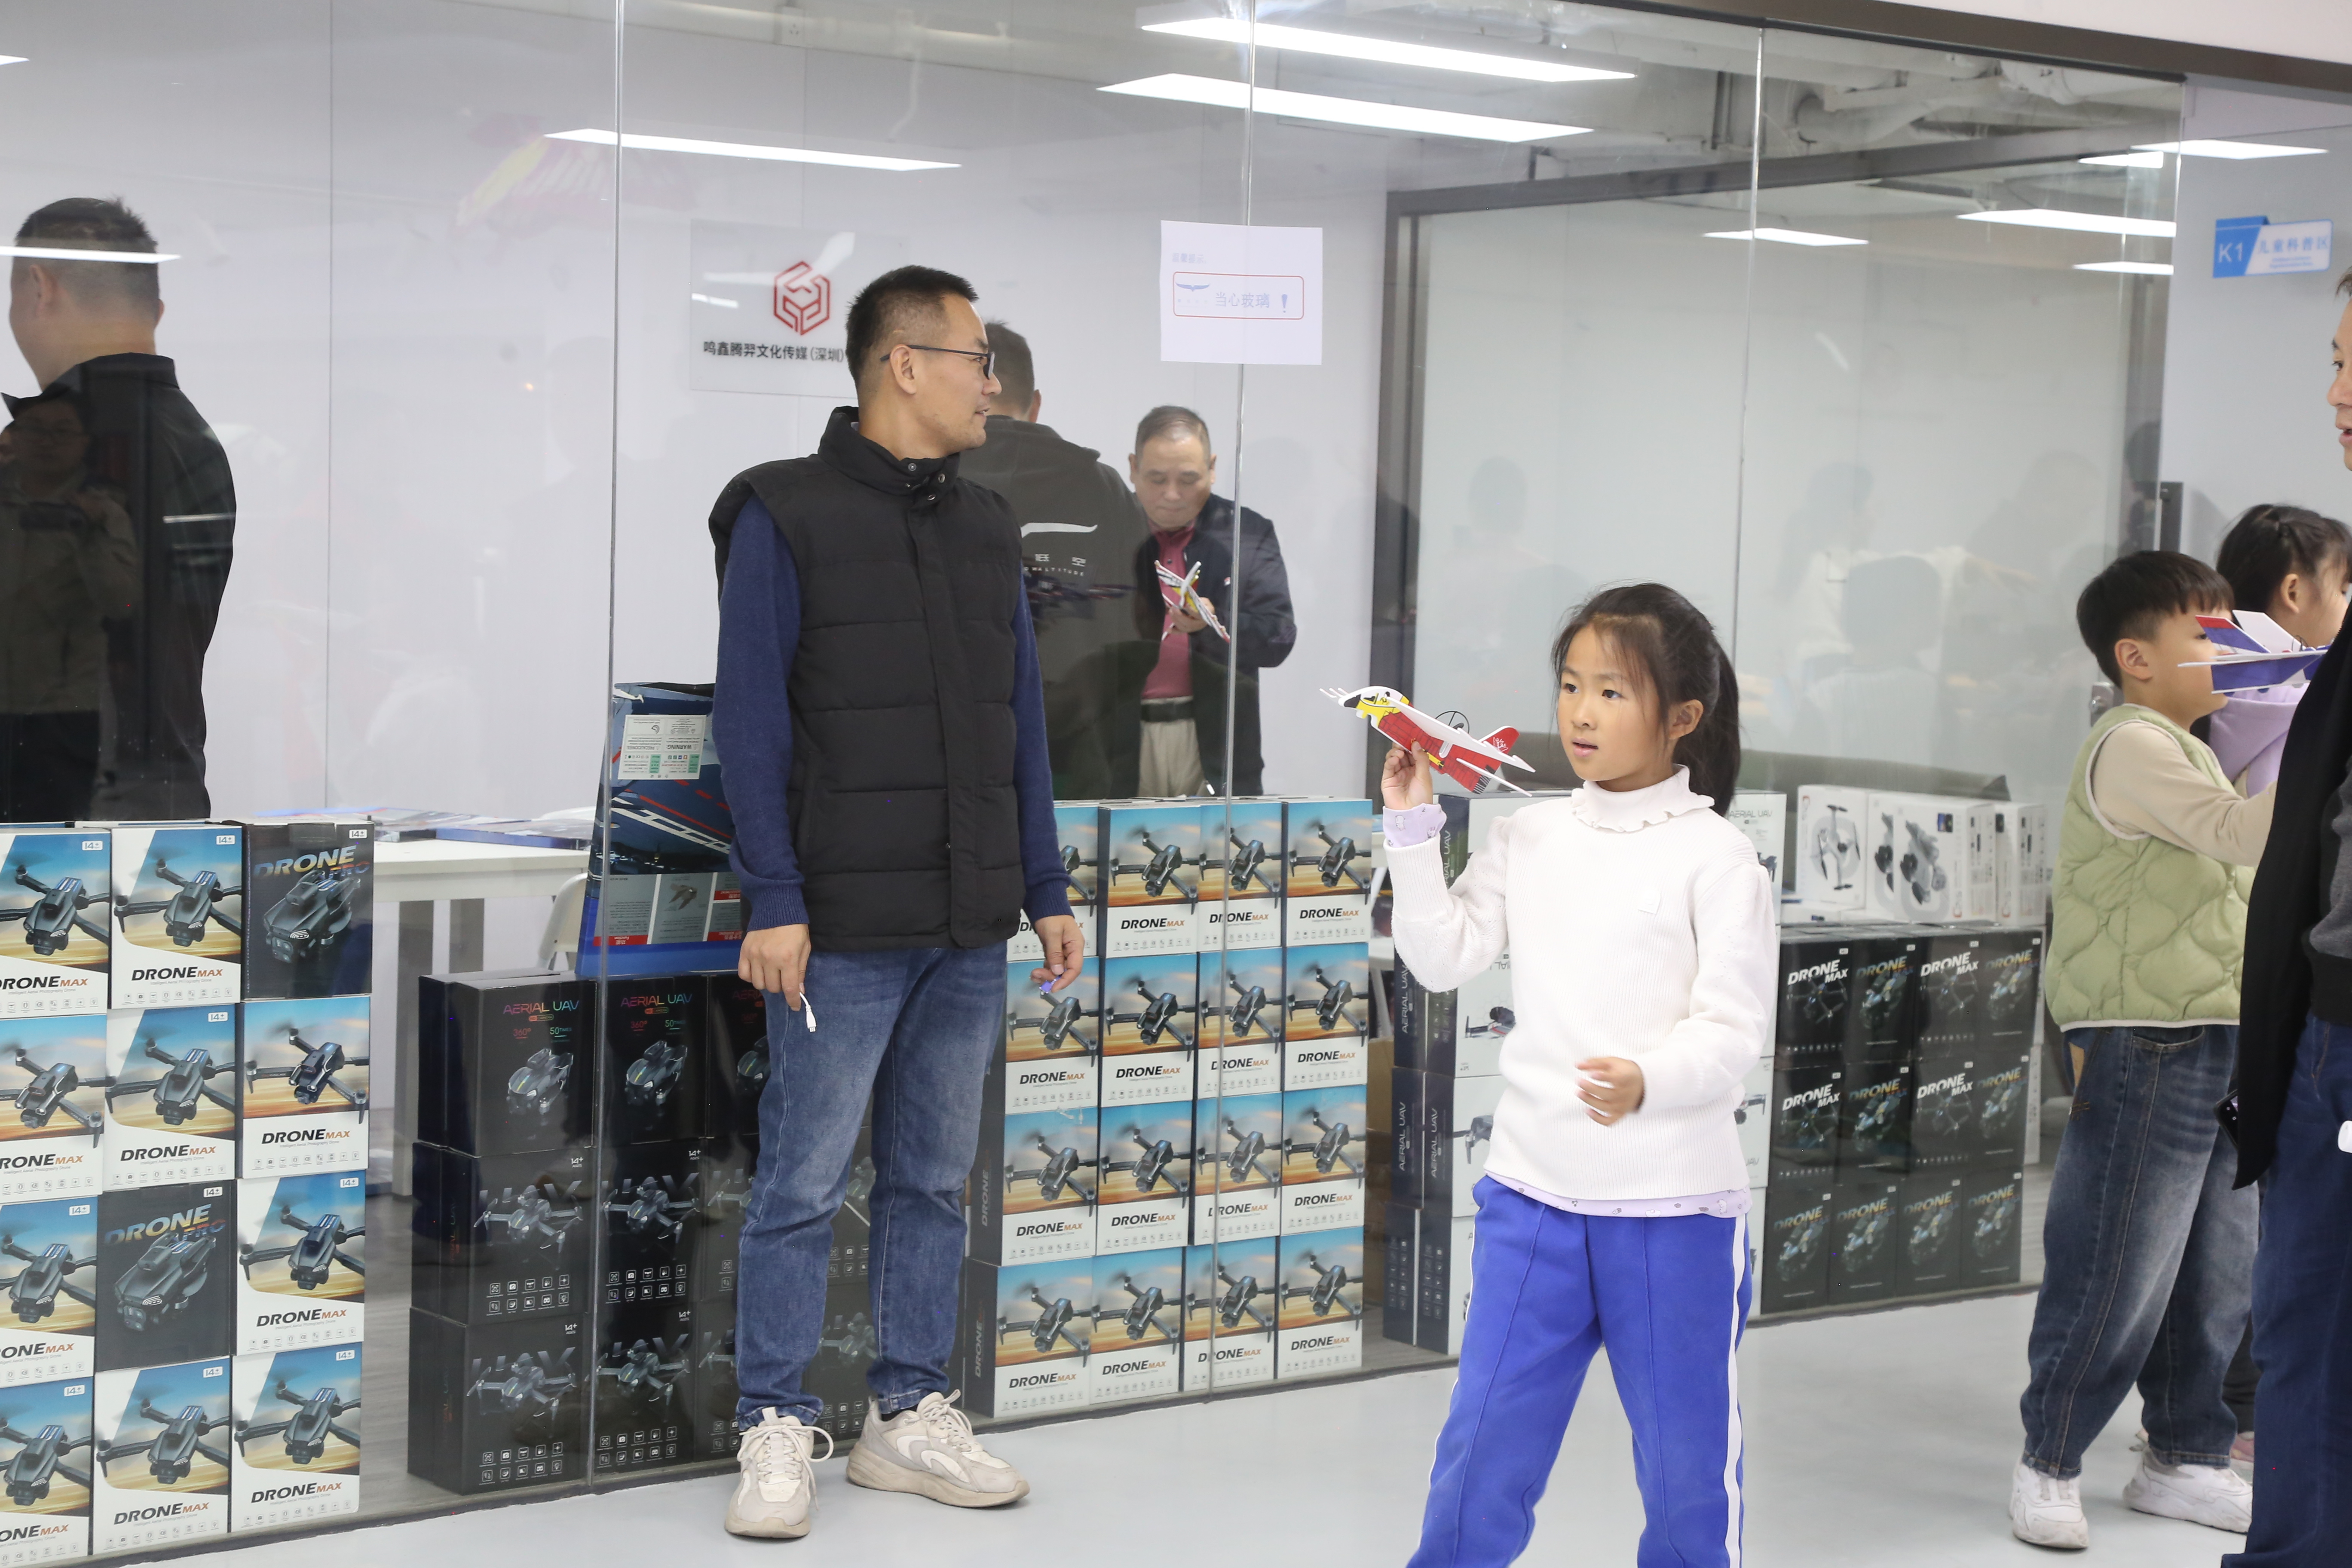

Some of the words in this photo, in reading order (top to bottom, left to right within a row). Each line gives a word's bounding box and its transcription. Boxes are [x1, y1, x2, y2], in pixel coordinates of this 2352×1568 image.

[2218, 242, 2243, 263] K1
[253, 845, 356, 877] DRONE
[328, 861, 370, 879] PRO
[1300, 908, 1342, 919] DRONE
[1121, 918, 1167, 929] DRONE
[1856, 956, 1907, 977] DRONE
[1921, 952, 1971, 977] DRONE
[1985, 949, 2033, 970] DRONE
[132, 967, 198, 981] DRONE
[197, 969, 224, 977] MAX
[1788, 959, 1840, 985] DRONE
[1825, 968, 1848, 983] MAX
[1957, 961, 1979, 975] MAX
[0, 976, 61, 989] RONE
[60, 979, 89, 987] MAX
[503, 1002, 549, 1014] AERIAL
[553, 1000, 580, 1011] UAV
[621, 996, 665, 1008] AERIAL
[668, 993, 693, 1004] UAV
[1298, 1051, 1339, 1063] DRONE
[1020, 1072, 1067, 1084] DRONE
[1116, 1066, 1163, 1078] DRONE
[1849, 1078, 1901, 1099] DRONE
[1917, 1072, 1966, 1099] DRONE
[1951, 1081, 1973, 1096] MAX
[1782, 1083, 1833, 1111] DRONE
[1818, 1092, 1841, 1108] MAX
[261, 1129, 326, 1144] DRONE
[325, 1131, 350, 1139] MAX
[120, 1145, 190, 1161] DRONE
[189, 1146, 216, 1155] MAX
[0, 1154, 56, 1169] RONE
[55, 1155, 84, 1164] MAX
[1295, 1194, 1337, 1207] DRONE
[1904, 1191, 1953, 1213] DRONE
[1837, 1197, 1888, 1220] DRONE
[1111, 1213, 1158, 1226] DRONE
[1774, 1205, 1823, 1228] DRONE
[104, 1204, 211, 1245] DRONE
[183, 1219, 226, 1241] PRO
[1017, 1222, 1064, 1236] DRONE
[257, 1309, 322, 1327] DRONE
[322, 1309, 347, 1319] MAX
[0, 1343, 46, 1358] ONE
[45, 1343, 75, 1354] MAX
[1291, 1336, 1334, 1351] DRONE
[1198, 1348, 1244, 1363] DONE
[1102, 1360, 1148, 1375] DRONE
[1009, 1373, 1058, 1388] DRONE
[251, 1482, 317, 1504] DRONE
[316, 1482, 342, 1492] MAX
[113, 1503, 183, 1525] DRONE
[182, 1502, 209, 1513] MAX
[0, 1525, 41, 1542] ONE
[40, 1524, 69, 1536] MAX
